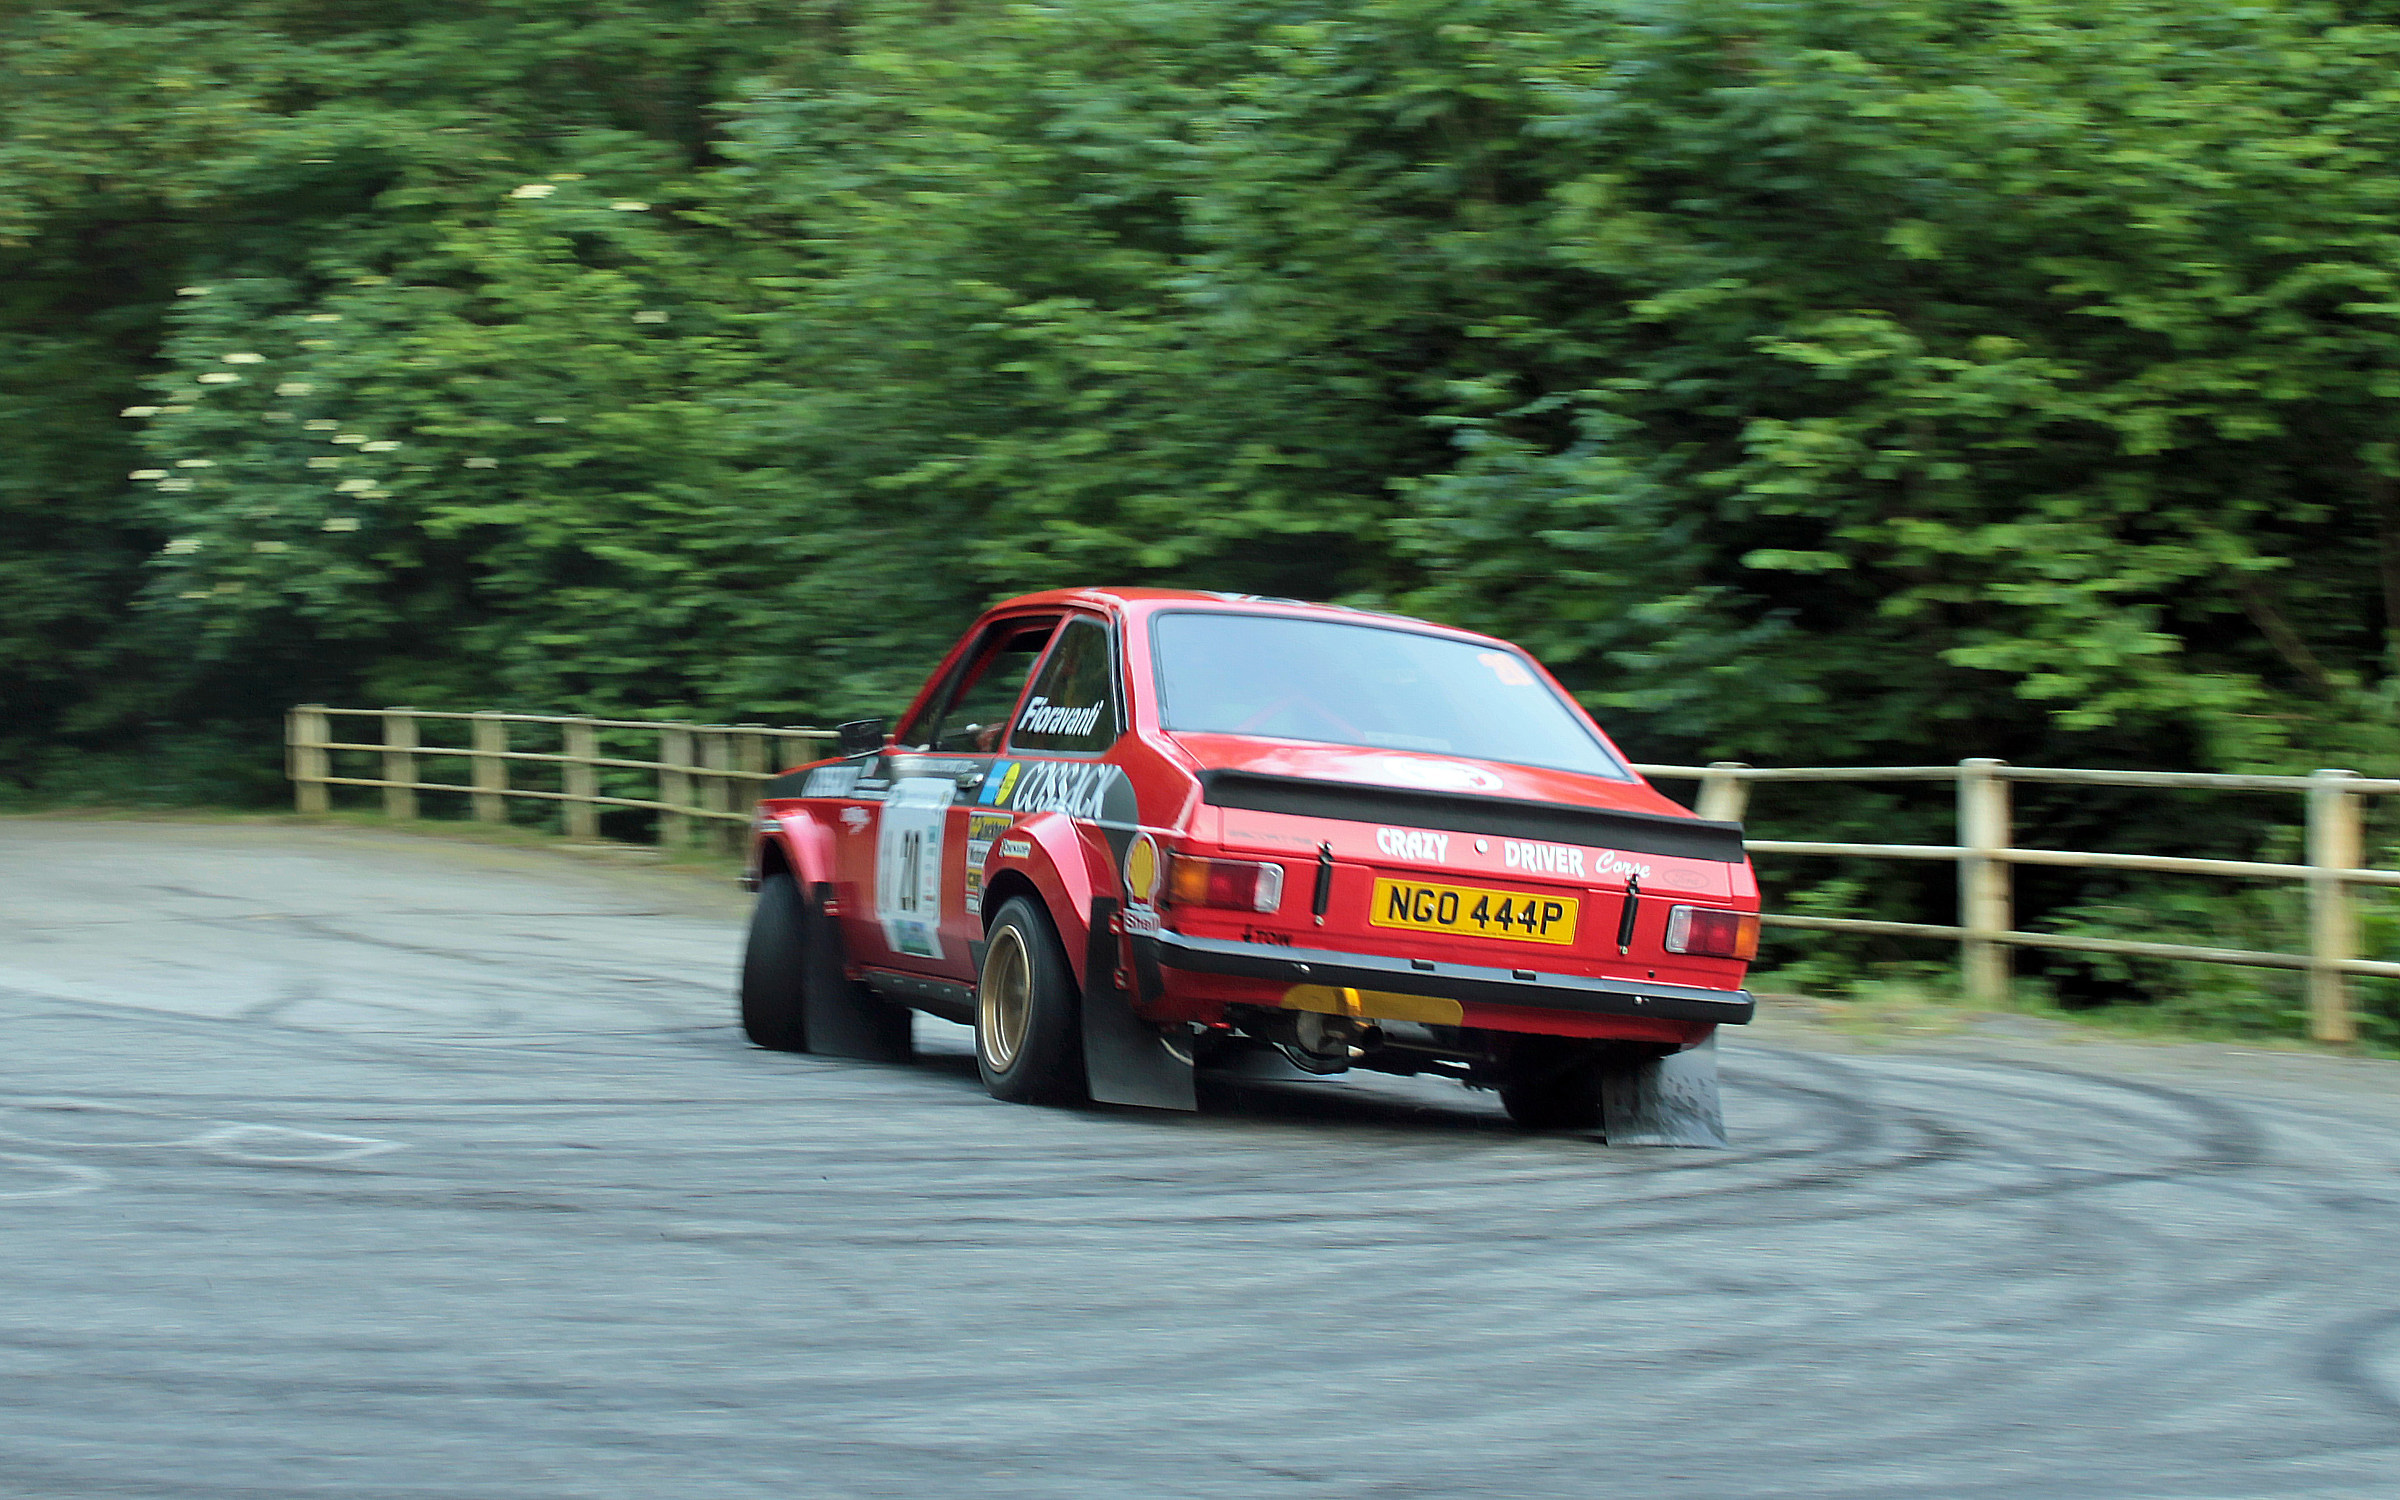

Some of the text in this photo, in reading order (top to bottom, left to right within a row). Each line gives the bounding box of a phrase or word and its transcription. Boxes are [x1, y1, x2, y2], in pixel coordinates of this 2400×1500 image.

[1017, 696, 1105, 736] Fioravanti
[1012, 760, 1123, 820] COSSACK
[1376, 827, 1651, 878] CRAZY DRIVER Corse
[1125, 912, 1161, 931] Shell
[1388, 885, 1564, 935] NGO 444P
